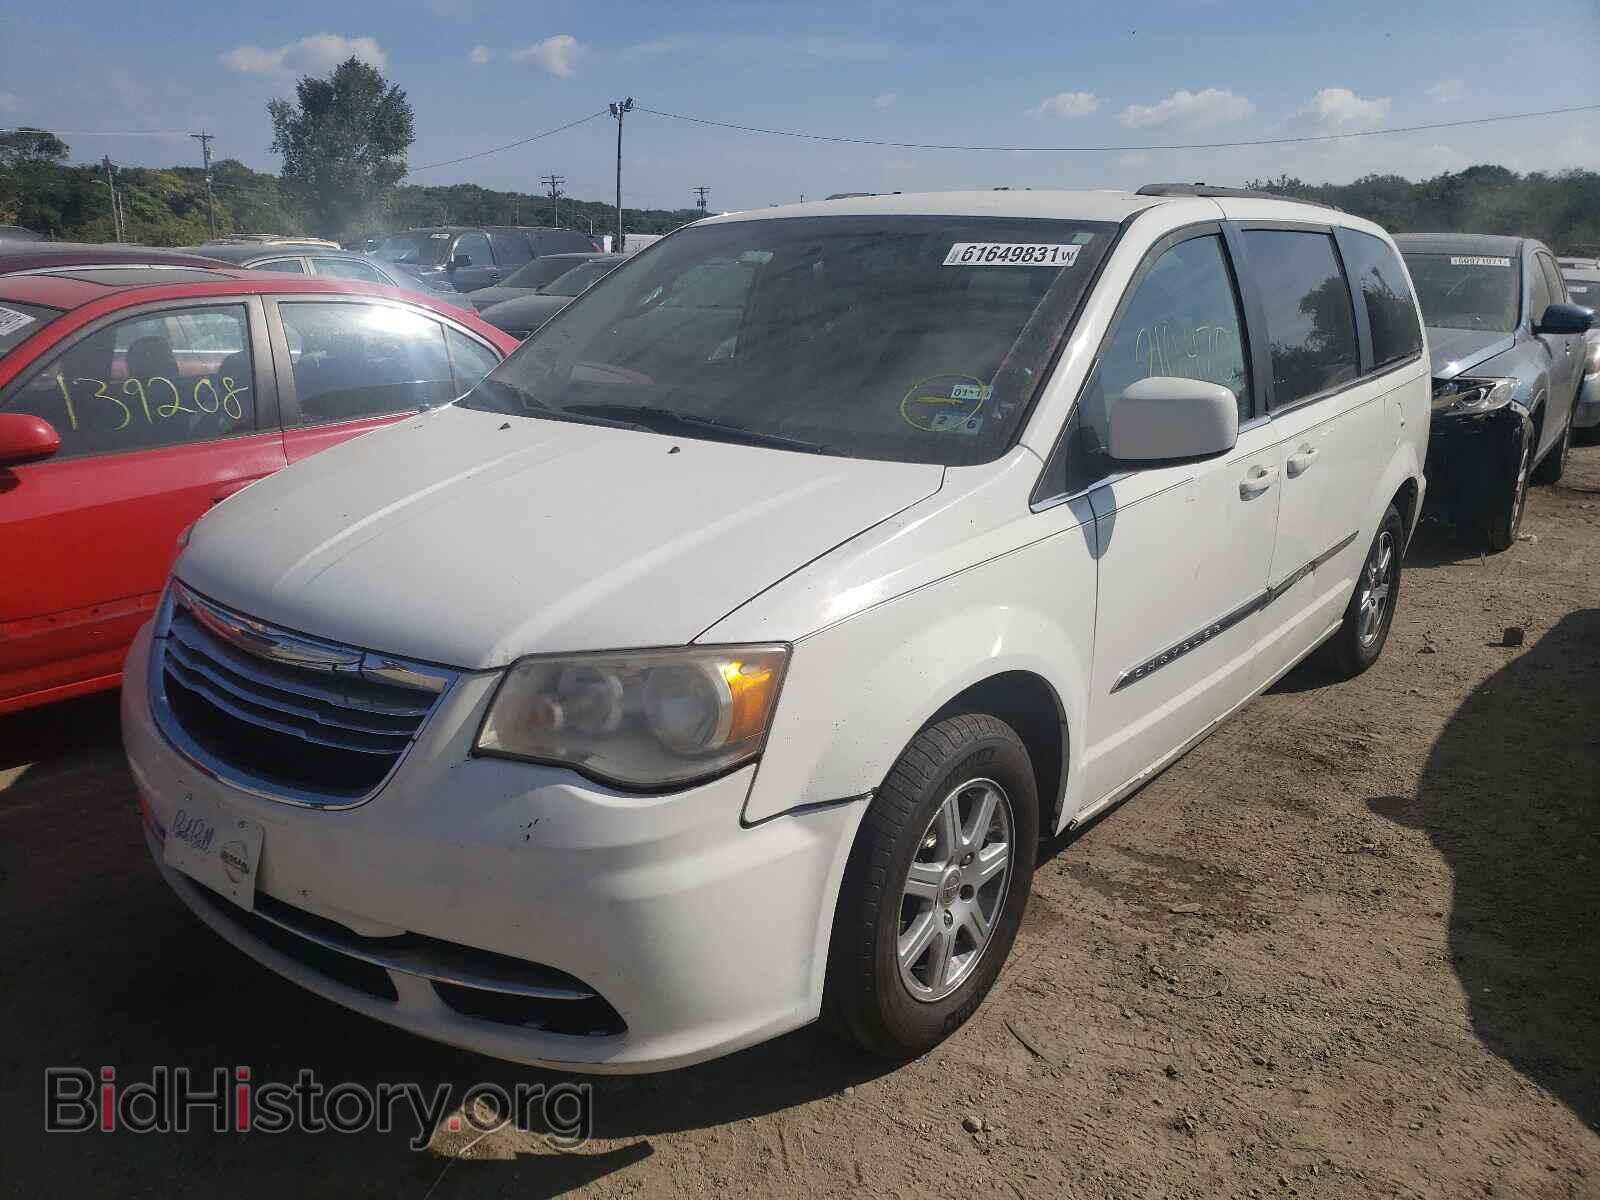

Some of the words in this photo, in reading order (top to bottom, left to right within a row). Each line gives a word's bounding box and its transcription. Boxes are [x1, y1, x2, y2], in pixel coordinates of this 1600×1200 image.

[961, 245, 1060, 263] 61649831
[56, 374, 249, 431] 139208
[1135, 624, 1221, 678] CHRYSLER
